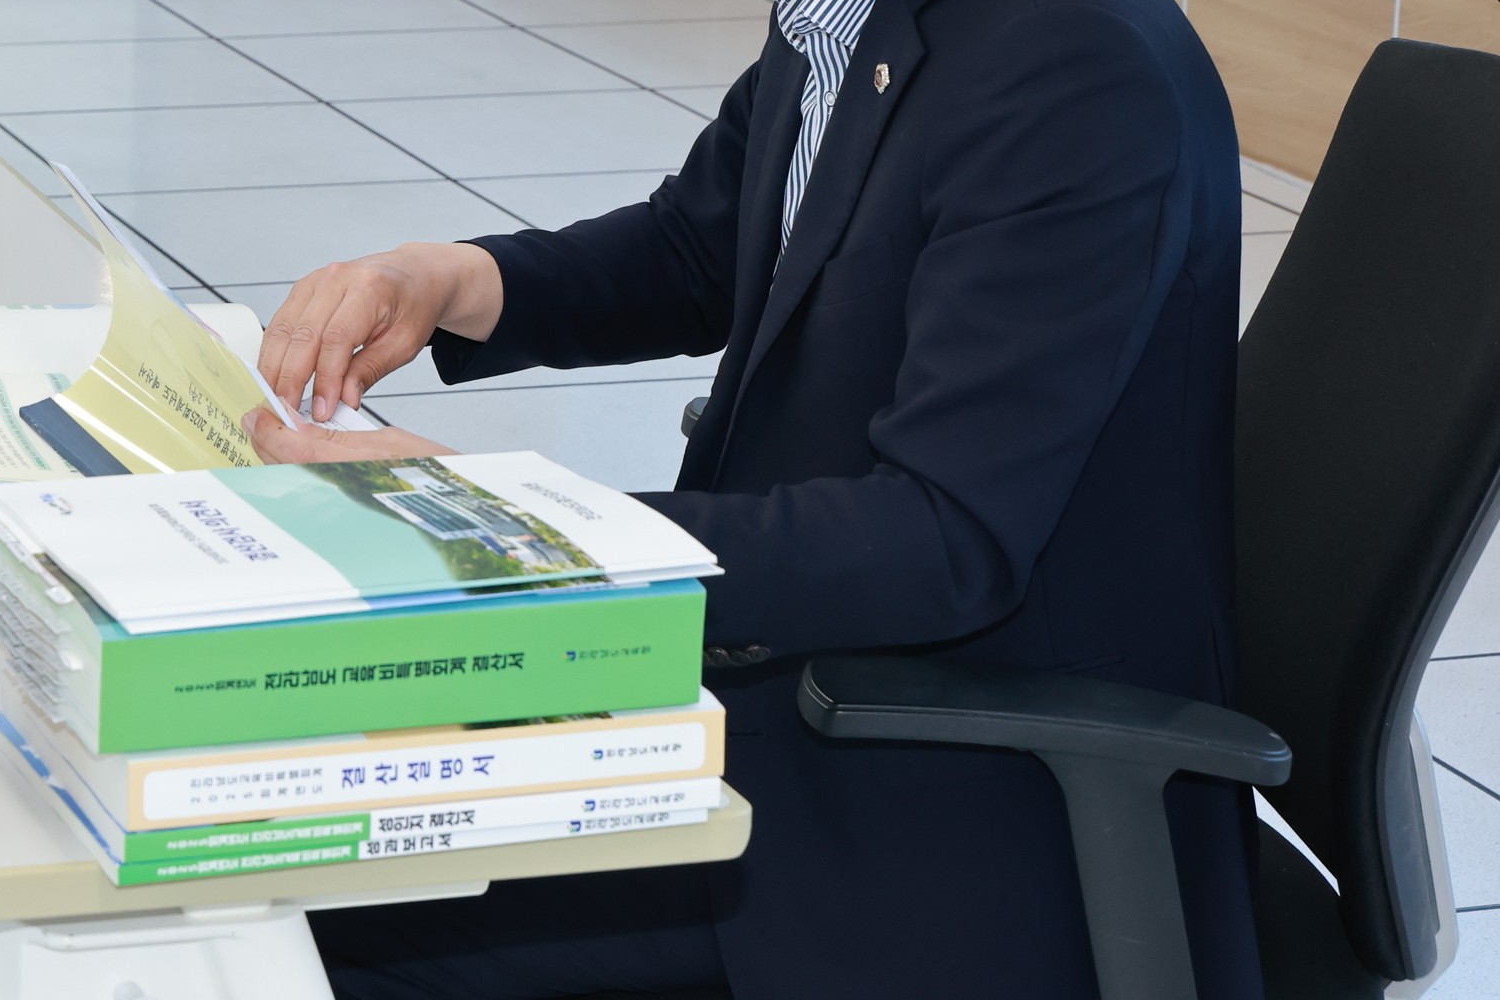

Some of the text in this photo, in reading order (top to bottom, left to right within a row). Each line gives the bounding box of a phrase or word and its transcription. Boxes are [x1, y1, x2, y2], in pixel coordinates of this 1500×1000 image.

[139, 361, 160, 389] 예산서
[162, 384, 207, 432] 2025회계년도
[264, 668, 337, 690] 전라남도
[342, 656, 467, 684] 교육비특별회계
[472, 651, 525, 673] 결산서
[341, 754, 496, 789] 결산설명서
[377, 809, 476, 832] 성인지 결산서
[366, 833, 452, 855] 성과보고서
